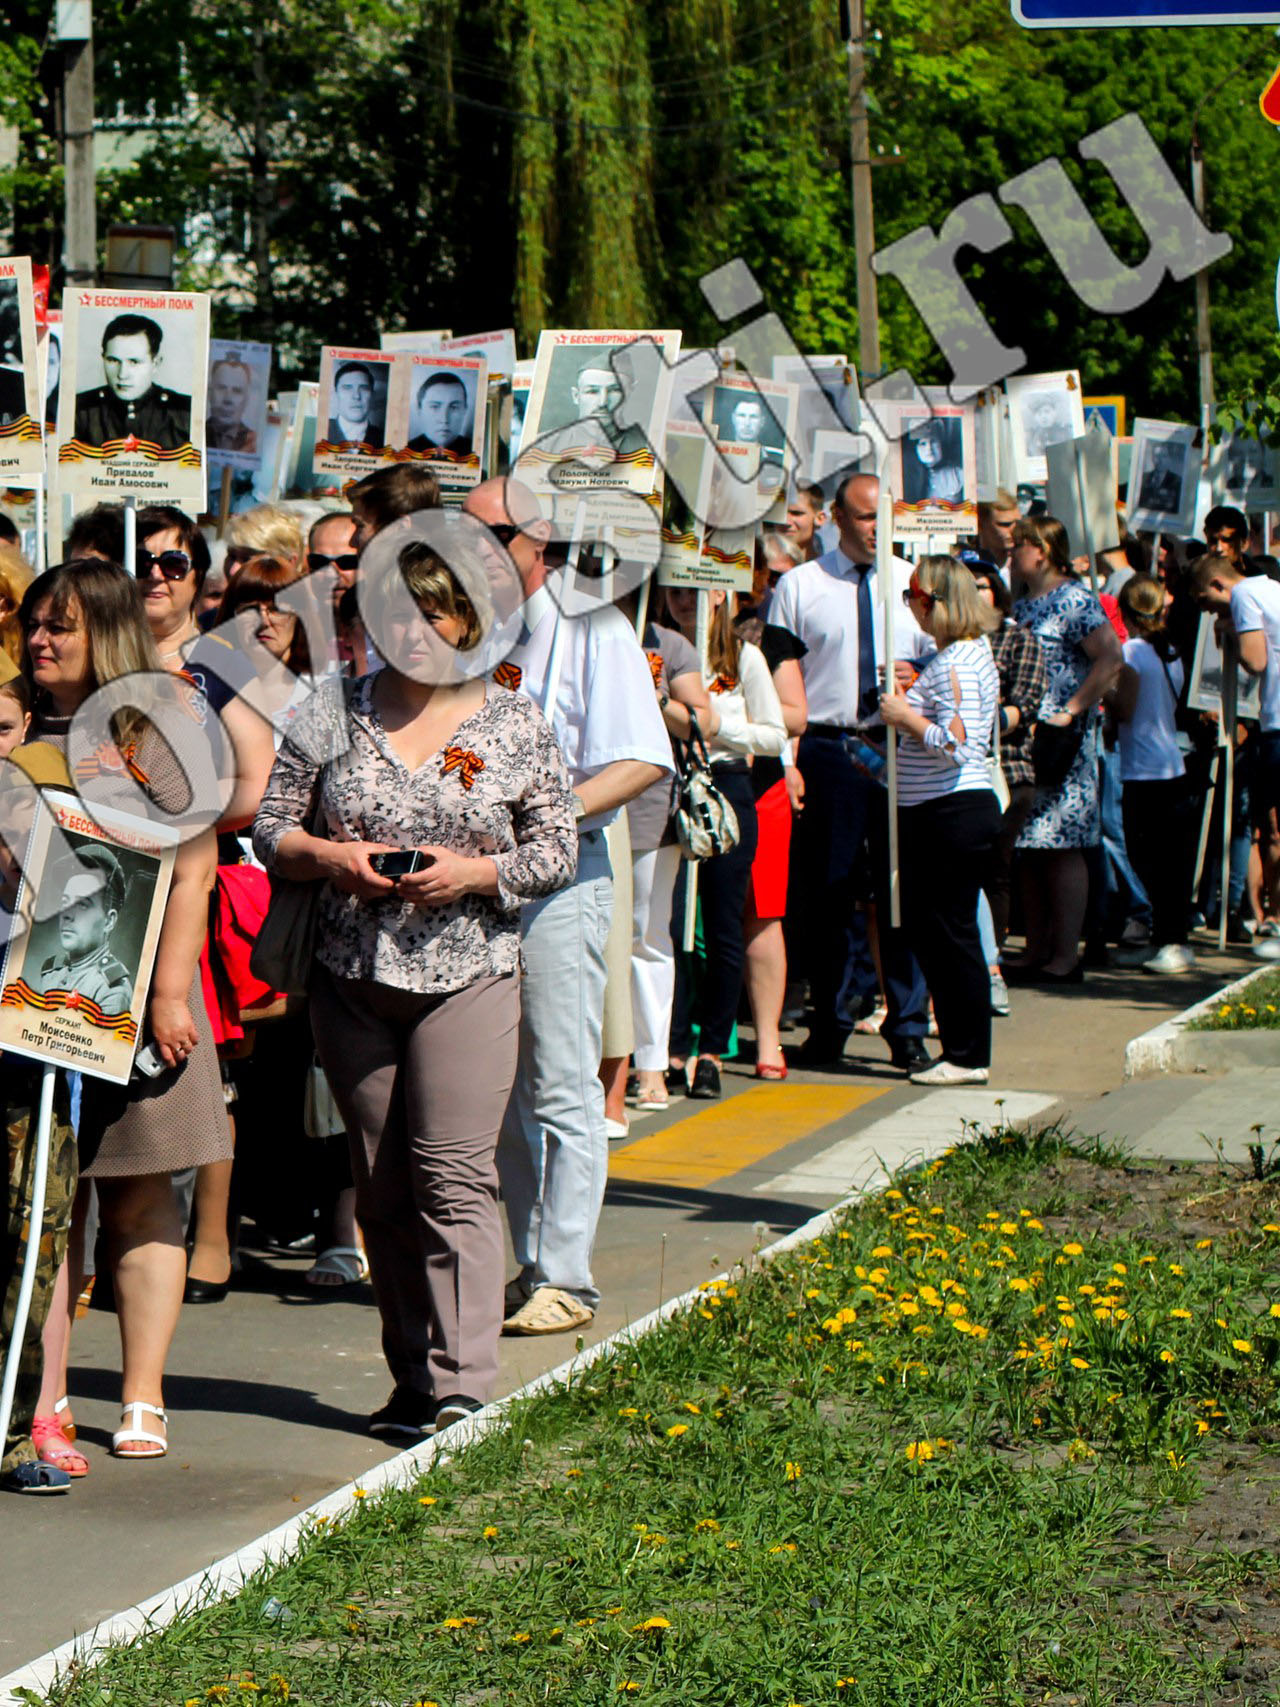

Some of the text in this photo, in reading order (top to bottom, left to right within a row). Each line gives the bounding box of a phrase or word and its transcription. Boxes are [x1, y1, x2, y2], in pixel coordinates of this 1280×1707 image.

[95, 294, 194, 310] БЕССМЕРТНЫЙ ПОЛК
[106, 466, 155, 478] Привалов
[91, 476, 169, 489] Иван Амосович
[589, 478, 630, 486] Нотович
[69, 814, 162, 855] БЕССМЕРТНЫЙ ПОЛК
[54, 1015, 82, 1030] СЕРЖАНТ
[39, 1021, 93, 1047] Моисеенко
[21, 1028, 106, 1064] Петр Григорьевич
